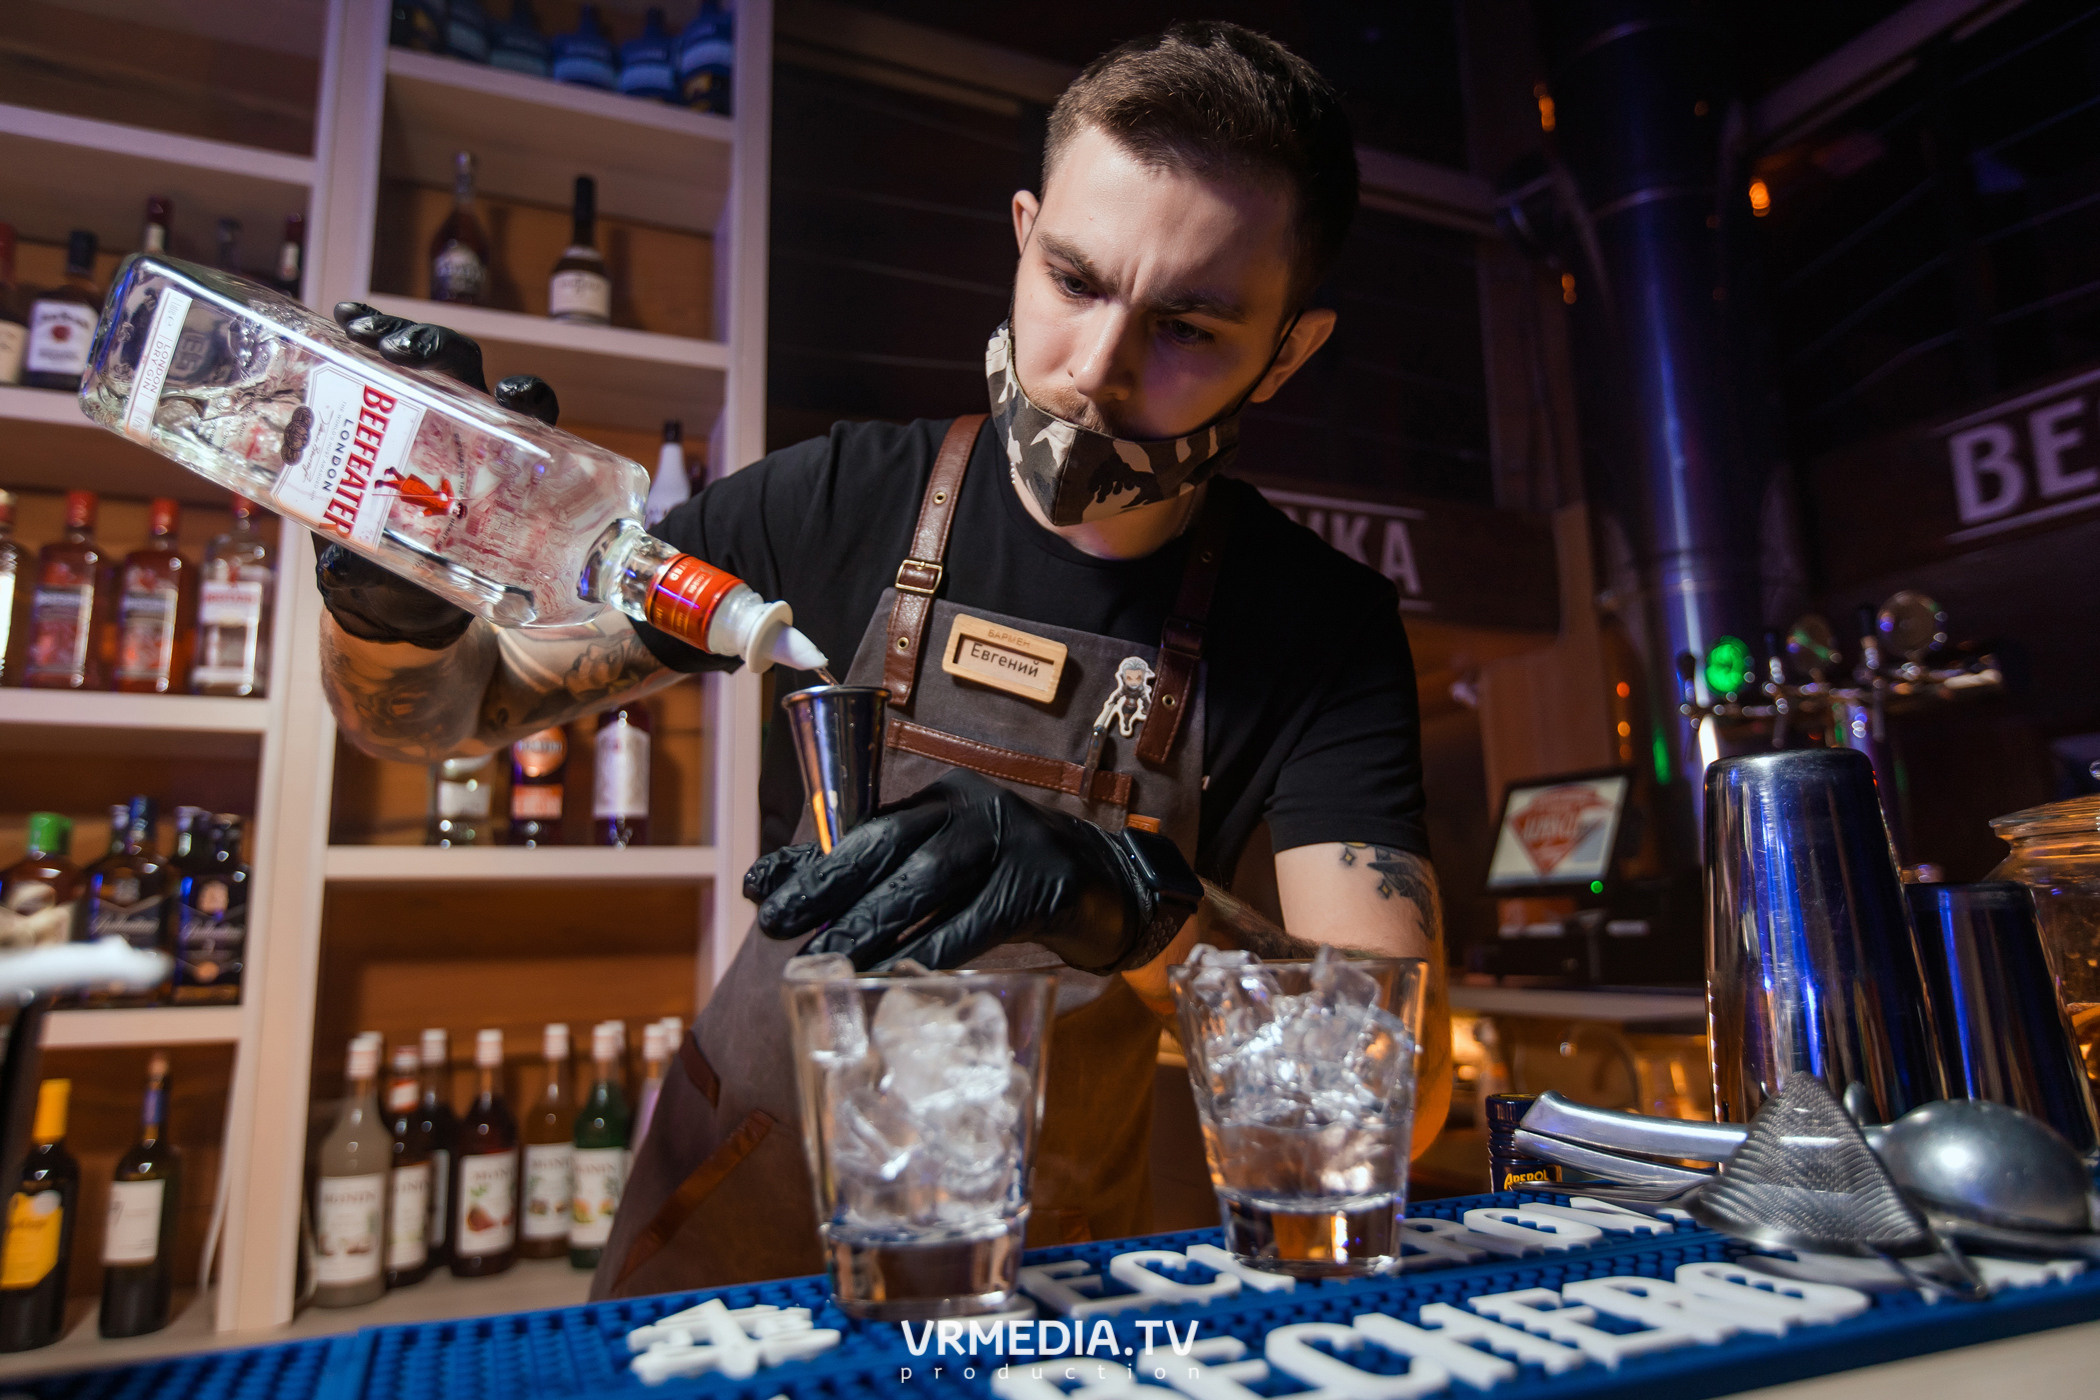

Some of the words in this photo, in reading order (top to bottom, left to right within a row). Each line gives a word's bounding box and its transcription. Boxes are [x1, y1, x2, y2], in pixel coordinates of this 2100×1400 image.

[149, 343, 171, 393] LONDON
[150, 340, 163, 366] DRY
[142, 368, 154, 390] GIN
[318, 384, 398, 541] BEEFEATER
[321, 418, 354, 492] LONDON
[1949, 398, 2099, 524] BE
[988, 629, 1031, 648] БАРМЕН
[970, 643, 1040, 678] Евгений
[1504, 1169, 1549, 1191] APEROL
